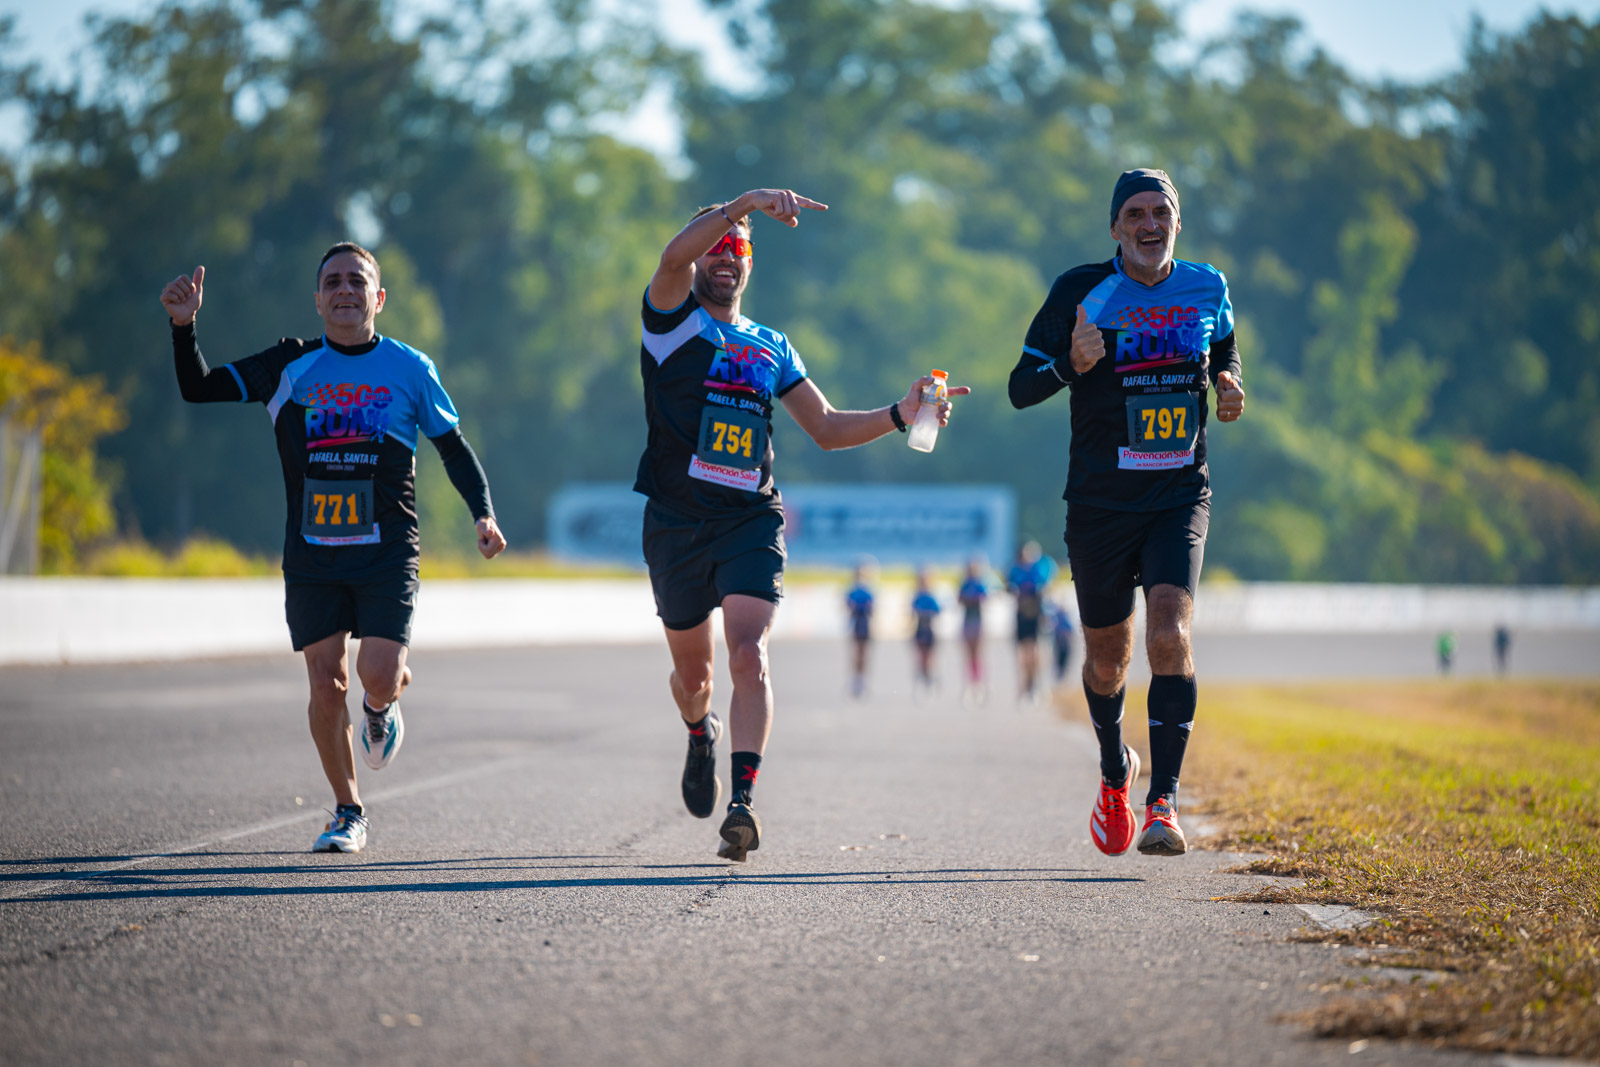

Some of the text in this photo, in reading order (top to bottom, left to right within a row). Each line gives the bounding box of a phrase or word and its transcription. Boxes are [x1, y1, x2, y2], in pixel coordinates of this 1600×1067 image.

[1115, 329, 1189, 362] RUN
[1122, 374, 1196, 388] RAFAELA, SANTA FE
[305, 407, 377, 438] RUN
[1142, 407, 1186, 440] 797
[712, 421, 753, 458] 754
[1173, 448, 1193, 458] Salu
[309, 452, 379, 465] RAFAELA, SANTA FE
[740, 470, 758, 482] Salud
[313, 493, 359, 525] 771
